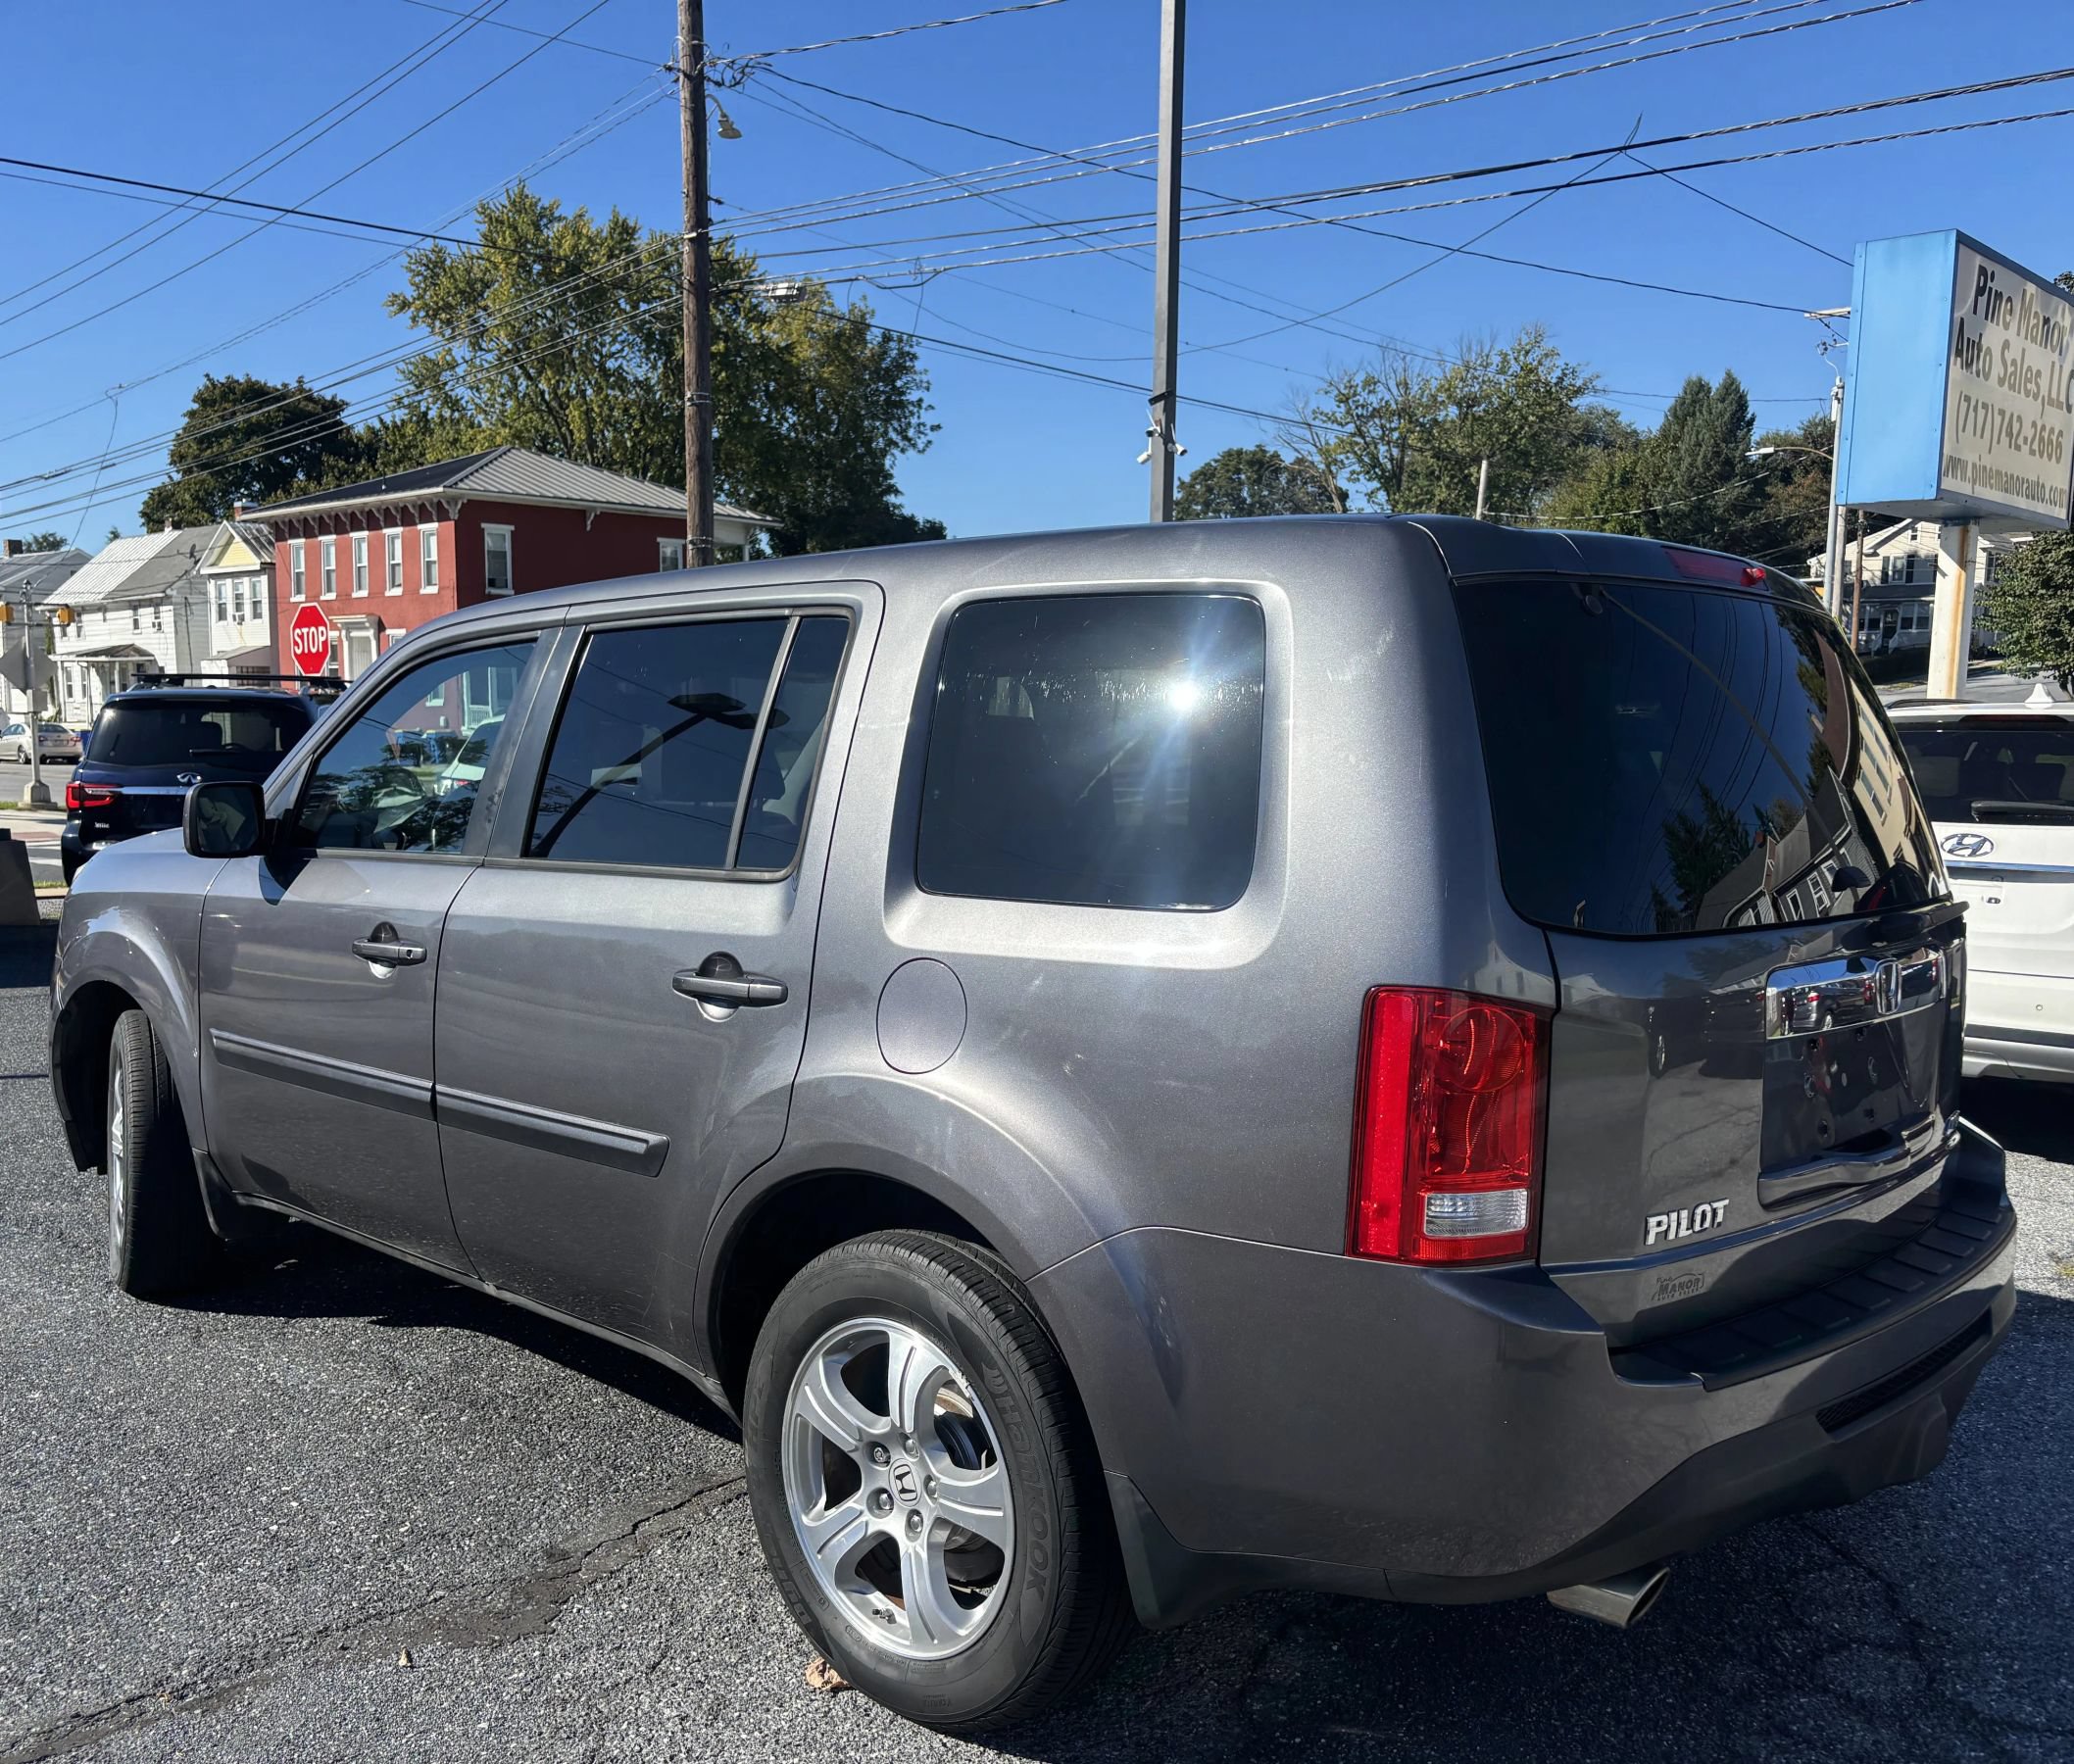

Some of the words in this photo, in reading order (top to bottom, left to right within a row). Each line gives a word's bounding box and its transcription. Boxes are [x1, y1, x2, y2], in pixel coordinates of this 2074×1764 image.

[1973, 264, 2013, 330] Pine
[2016, 288, 2068, 356] Manor
[1952, 317, 1994, 382] Auto
[1943, 454, 2067, 509] www.pinemanorauto.com
[294, 625, 327, 655] STOP
[1645, 1198, 1730, 1246] PILOT
[1658, 1278, 1701, 1296] MANOR
